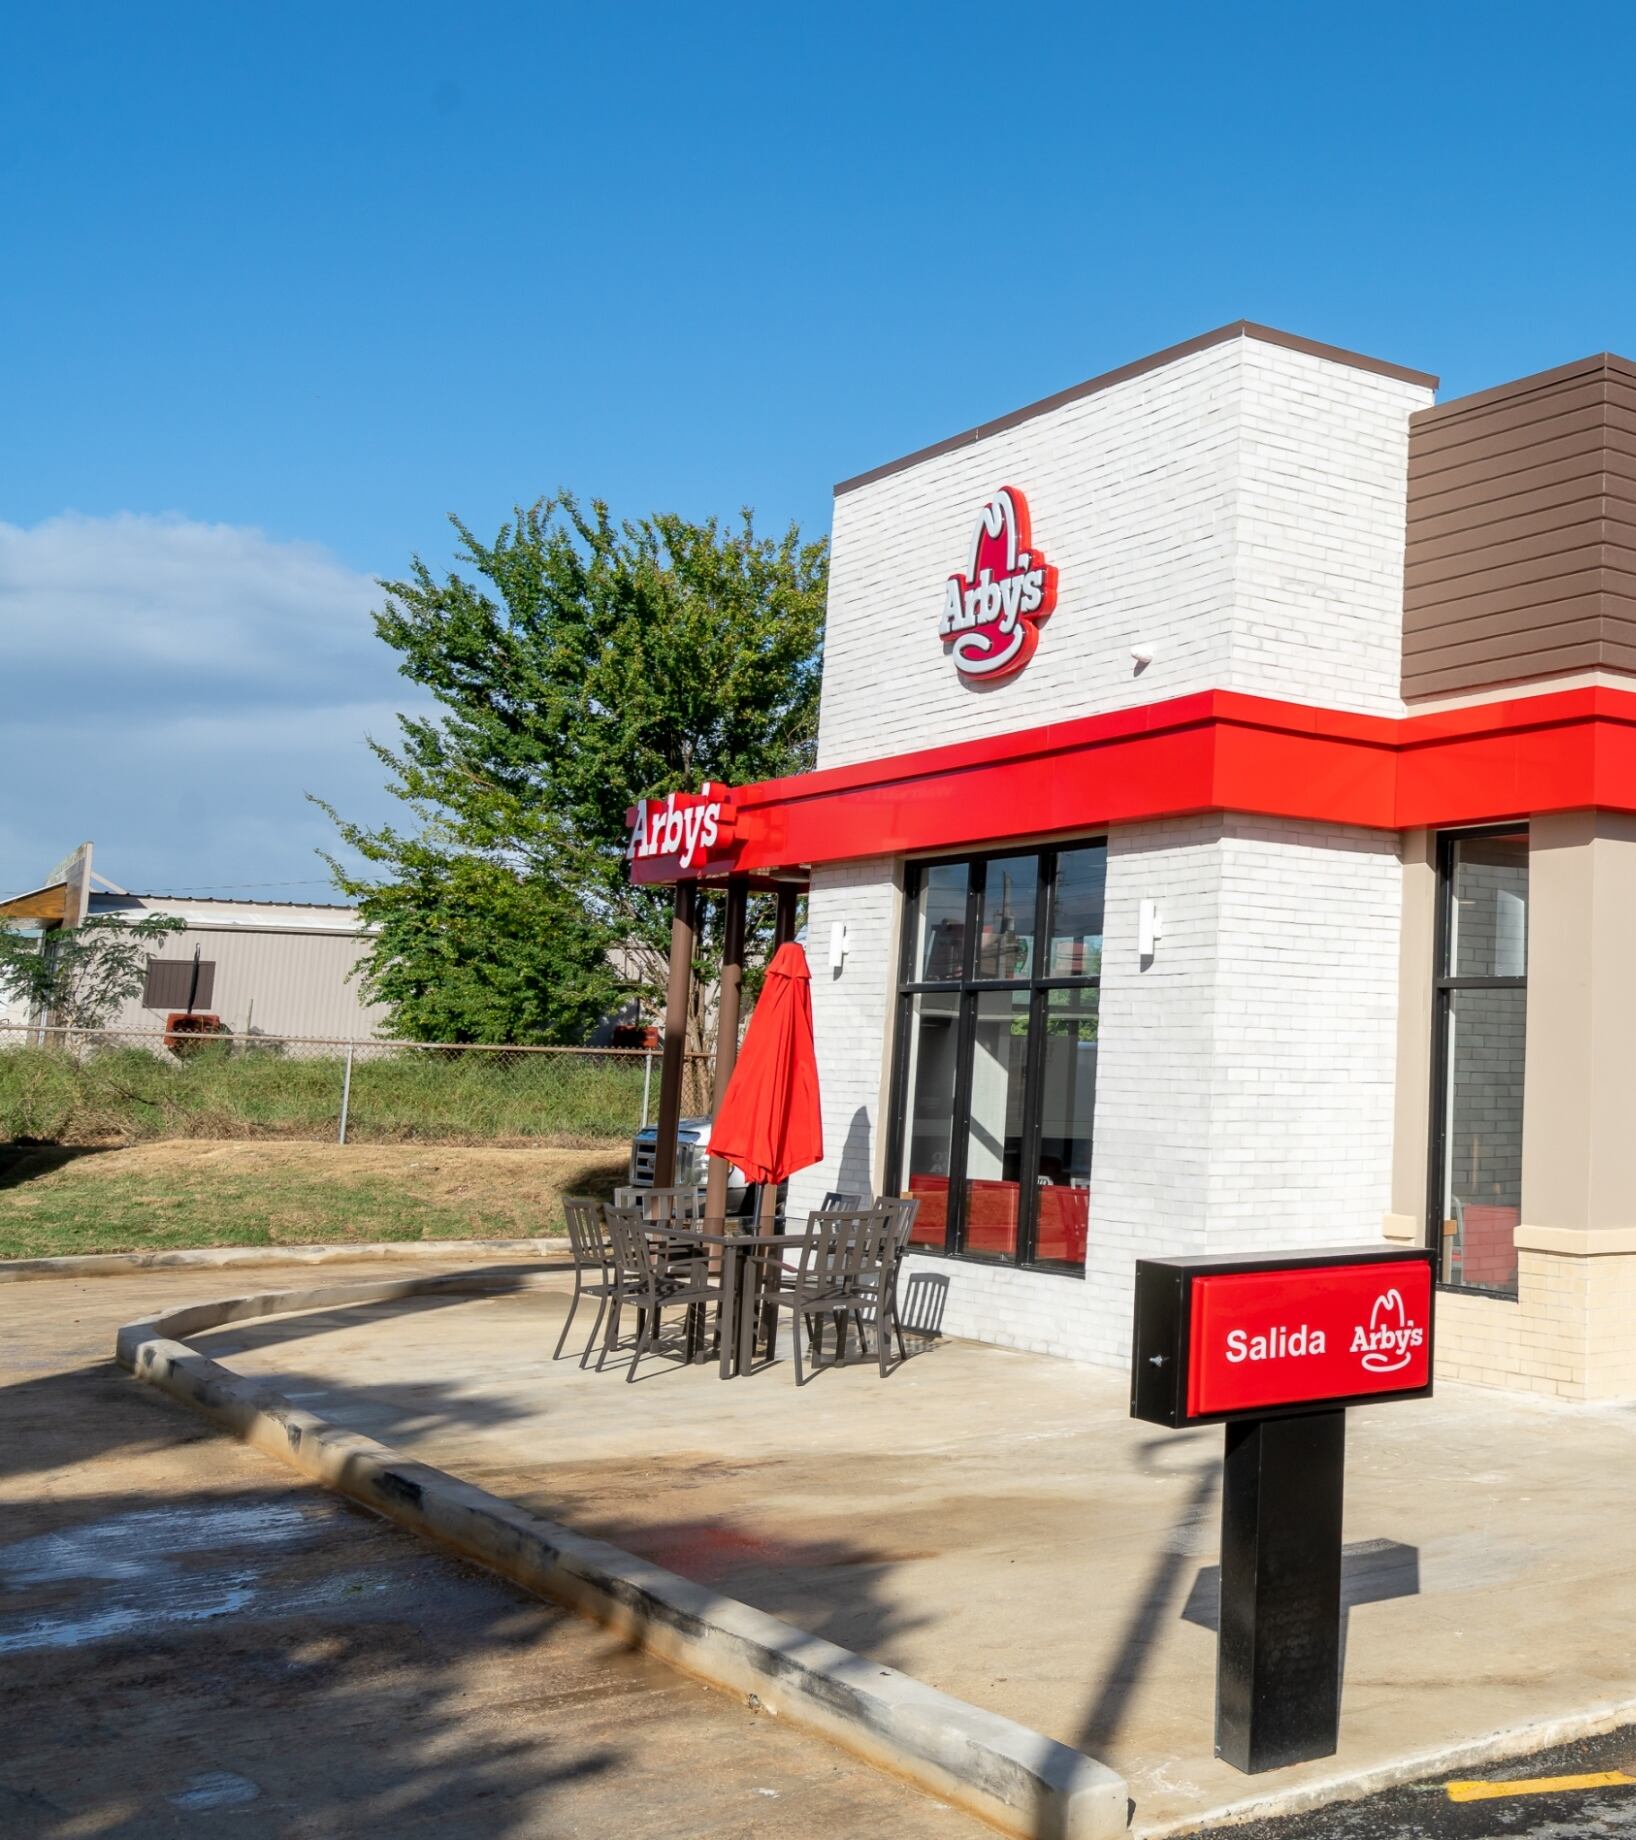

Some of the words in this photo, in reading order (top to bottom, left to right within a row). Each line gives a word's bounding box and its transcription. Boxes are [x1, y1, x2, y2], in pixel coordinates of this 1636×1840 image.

[938, 553, 1044, 634] Arby's
[626, 782, 721, 869] Arby's
[1226, 1324, 1326, 1364] Salida
[1349, 1319, 1424, 1356] Arby's
